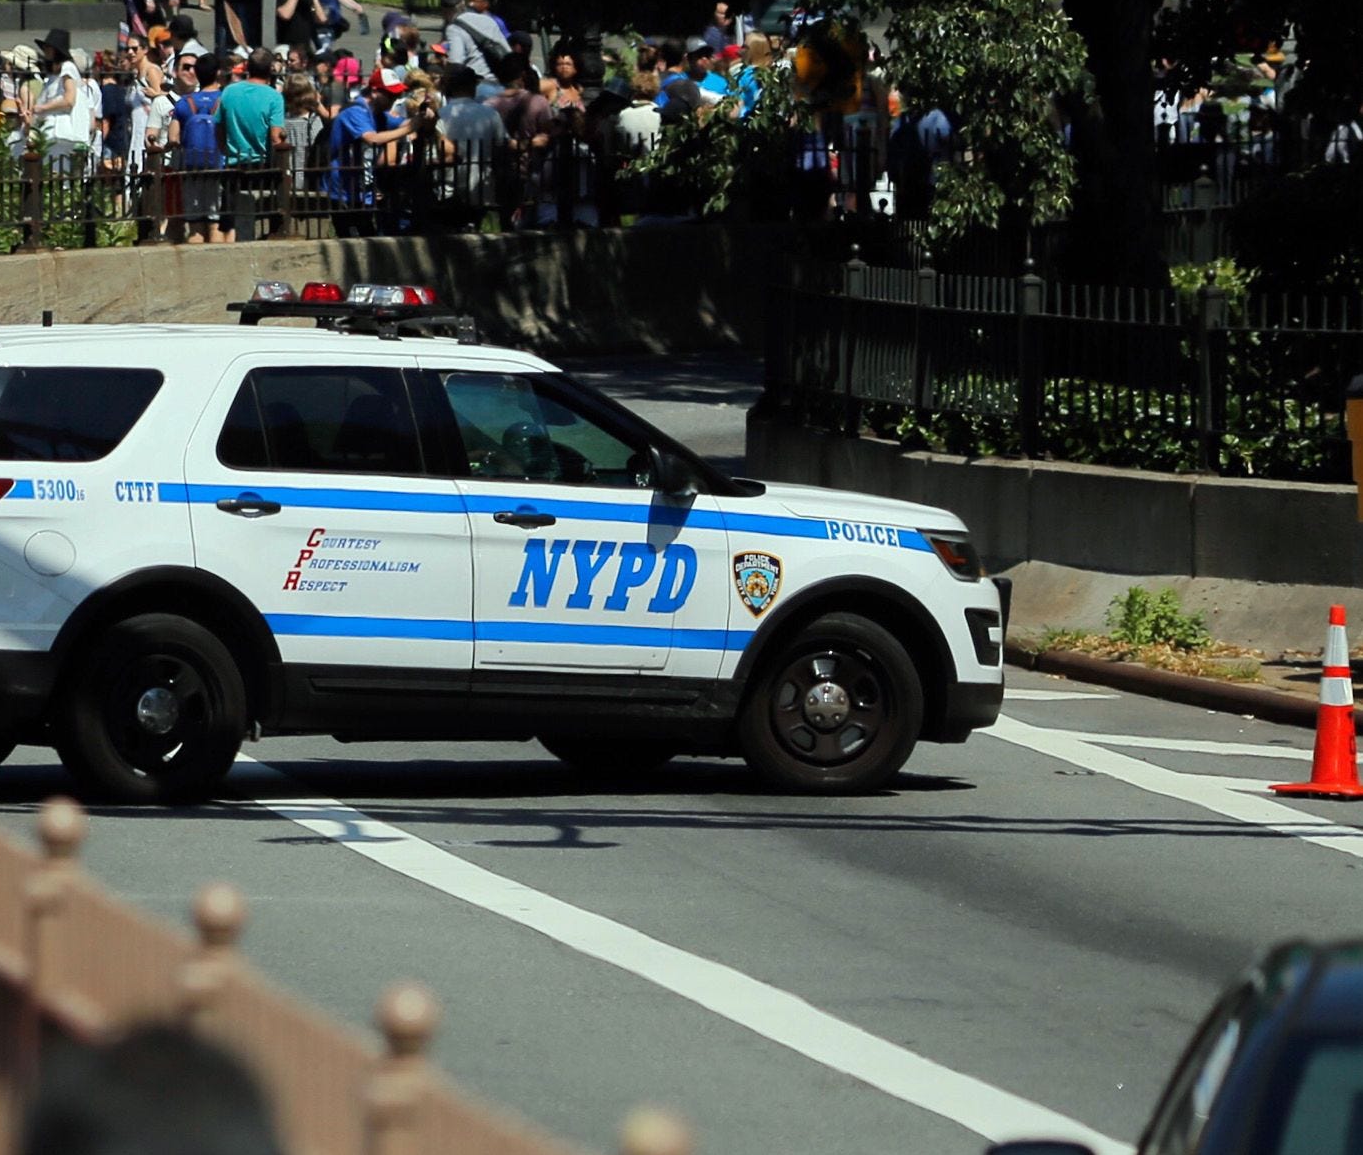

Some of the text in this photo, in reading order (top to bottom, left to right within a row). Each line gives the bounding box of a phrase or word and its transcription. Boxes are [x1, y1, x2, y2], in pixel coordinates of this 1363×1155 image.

[36, 479, 76, 501] 5300
[115, 481, 155, 503] CTTF
[306, 528, 382, 550] COURTESY
[828, 520, 900, 548] POLICE
[294, 549, 422, 573] PROFESSIONALISM
[282, 571, 348, 592] RESPECT
[508, 538, 698, 614] NYPD
